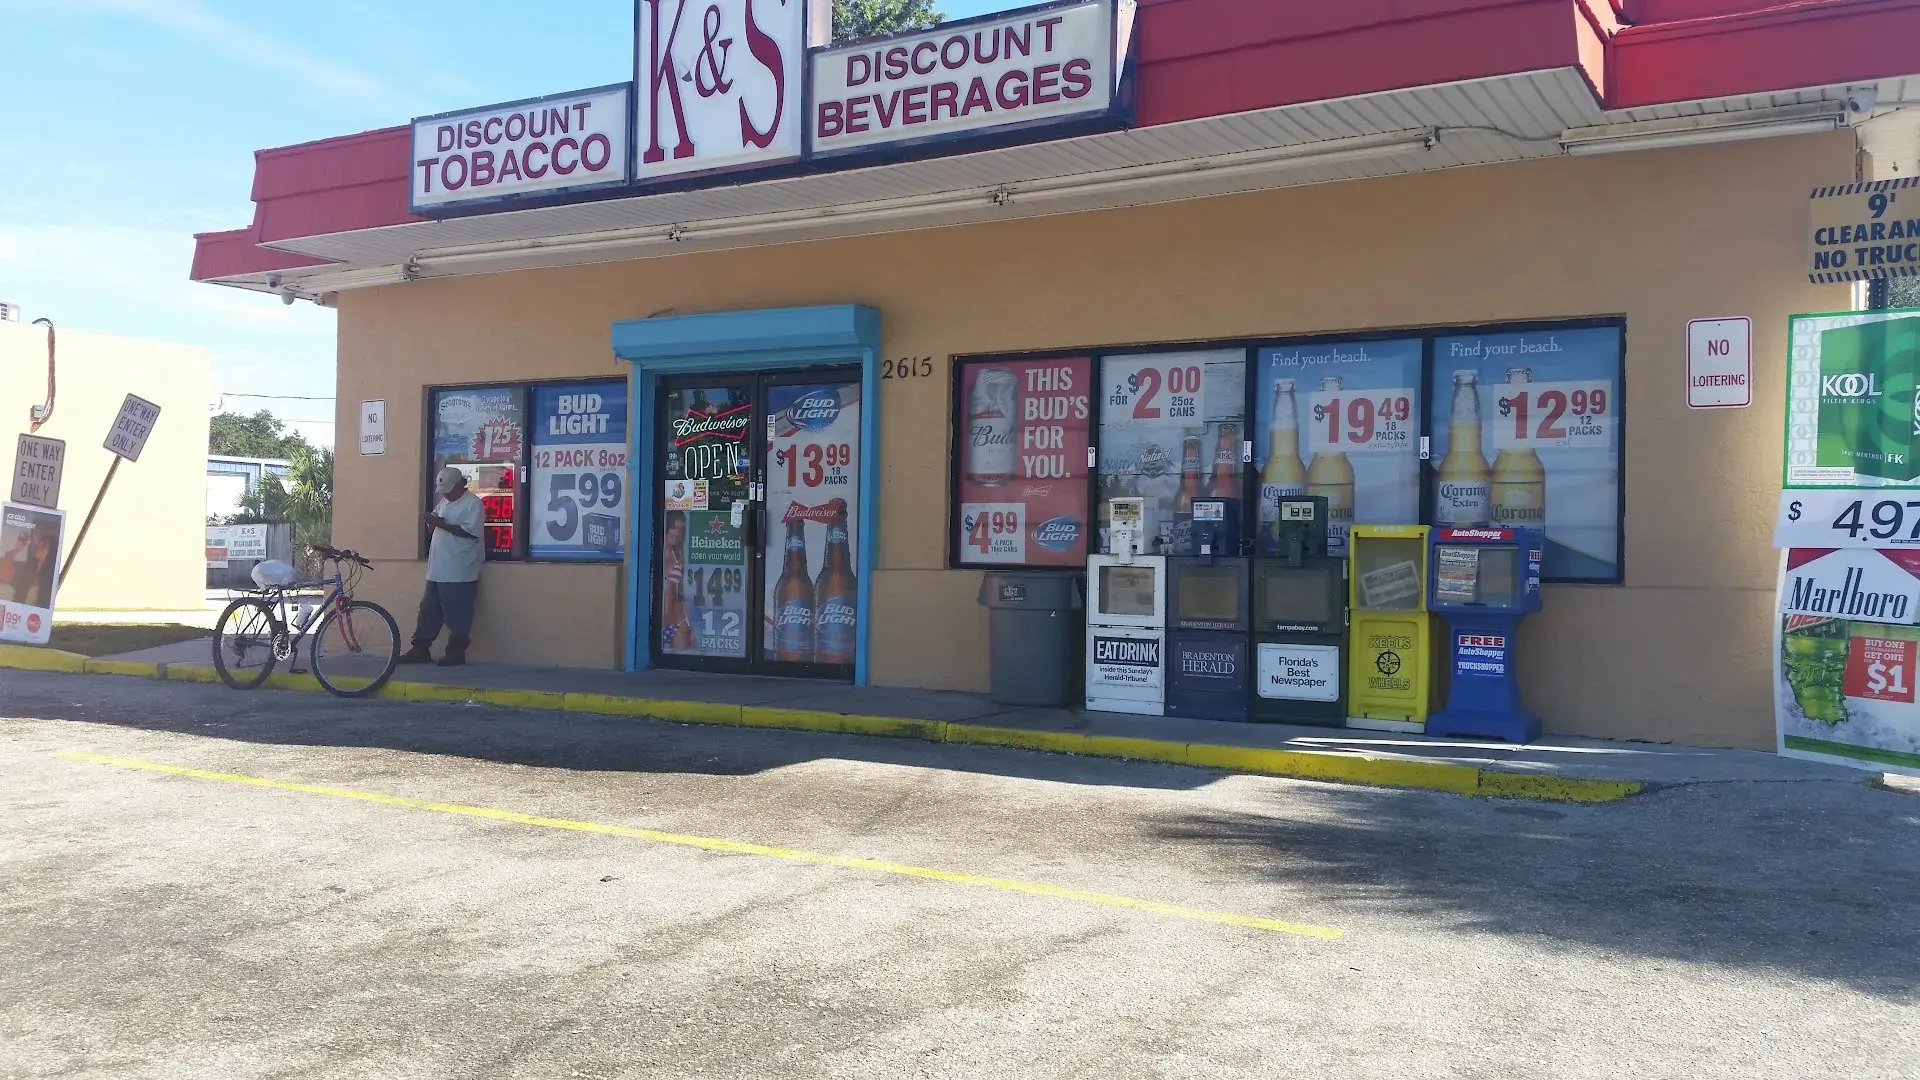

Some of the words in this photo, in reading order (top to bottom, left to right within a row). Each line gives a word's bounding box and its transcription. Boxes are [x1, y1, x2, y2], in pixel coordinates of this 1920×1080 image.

[846, 16, 1063, 88] DISCOUNT
[817, 58, 1093, 138] BEVERAGES
[436, 101, 592, 153] DISCOUNT
[416, 133, 611, 193] TOBACCO
[1814, 249, 1847, 270] NO
[1854, 243, 1920, 266] TRUC
[1450, 339, 1482, 358] Find
[1483, 343, 1517, 361] your
[1518, 336, 1564, 355] beach.
[1708, 339, 1730, 356] NO
[1271, 350, 1300, 367] Find
[1300, 354, 1330, 370] your
[1332, 346, 1371, 364] beach.
[881, 355, 933, 380] 2615
[1024, 366, 1073, 392] THIS
[1693, 373, 1746, 388] LOITERING
[1822, 373, 1882, 397] KOOL
[1115, 384, 1122, 395] 2
[558, 393, 602, 415] BUD
[802, 398, 835, 409] BUD
[1109, 395, 1128, 406] FOR
[1171, 396, 1194, 407] 25oz
[124, 399, 141, 416] ONE
[140, 405, 156, 423] WAY
[794, 409, 839, 420] LIGHT
[1024, 395, 1089, 421] BUD'S
[1169, 406, 1196, 418] CANS
[368, 413, 378, 424] NO
[549, 413, 610, 435] LIGHT
[1579, 415, 1592, 425] 12
[118, 416, 147, 440] ENTER
[673, 415, 748, 436] Budweiser
[1385, 421, 1397, 431] 18
[1568, 425, 1603, 436] PACKS
[362, 434, 384, 443] LOITERING
[1023, 425, 1065, 450] FOR
[1375, 430, 1406, 441] PACKS
[113, 433, 137, 454] ONLY
[20, 440, 38, 459] ONE
[41, 443, 61, 462] WAY
[1138, 448, 1172, 464] Natural
[534, 451, 551, 469] 12
[554, 449, 595, 468] PACK
[598, 449, 626, 468] 8oz
[684, 441, 741, 480] OPEN
[1887, 453, 1904, 464] FK
[20, 461, 56, 482] ENTER
[831, 466, 841, 475] 18
[1022, 454, 1071, 479] YOU.
[824, 476, 848, 485] PACKS
[20, 482, 50, 502] ONLY
[1452, 497, 1479, 507] Extra
[786, 504, 837, 518] Budweiser
[1788, 500, 1802, 522] $
[6, 519, 36, 529] REFRESHMENT
[589, 523, 605, 536] BUD
[1044, 523, 1076, 533] BUD
[492, 526, 512, 548] 73
[587, 532, 607, 546] LIGHT
[1038, 531, 1080, 542] LIGHT
[1451, 529, 1502, 540] AutoShopper
[691, 536, 742, 549] Heineken
[691, 552, 707, 561] open
[708, 552, 722, 561] your
[723, 552, 741, 560] world
[1788, 567, 1908, 620] Marlboro
[784, 605, 811, 617] BUD
[824, 604, 855, 616] BUD
[701, 610, 740, 637] 12
[778, 615, 811, 626] LIGHT
[818, 614, 856, 626] LIGHT
[1180, 621, 1212, 629] BRADENTON
[1277, 624, 1319, 632] tampabay.com
[700, 637, 740, 650] PACKS
[1459, 635, 1504, 647] FREE
[1865, 639, 1883, 648] BUY
[1884, 640, 1904, 649] ONE
[1181, 651, 1235, 662] BRADENTON
[1458, 647, 1505, 658] AutoShopper
[1864, 651, 1882, 660] GET
[1883, 652, 1904, 662] ONE
[1181, 660, 1236, 675] HERALD
[1278, 656, 1319, 668] Florida's
[1099, 666, 1117, 674] inside
[1116, 665, 1128, 674] this
[1127, 667, 1153, 676] Sunday's
[1287, 667, 1311, 678] Best
[1104, 673, 1148, 683] Herald-Tribune!
[1271, 675, 1327, 688] Newspaper
[1368, 676, 1411, 690] WHEELS
[1867, 660, 1907, 695] $1
